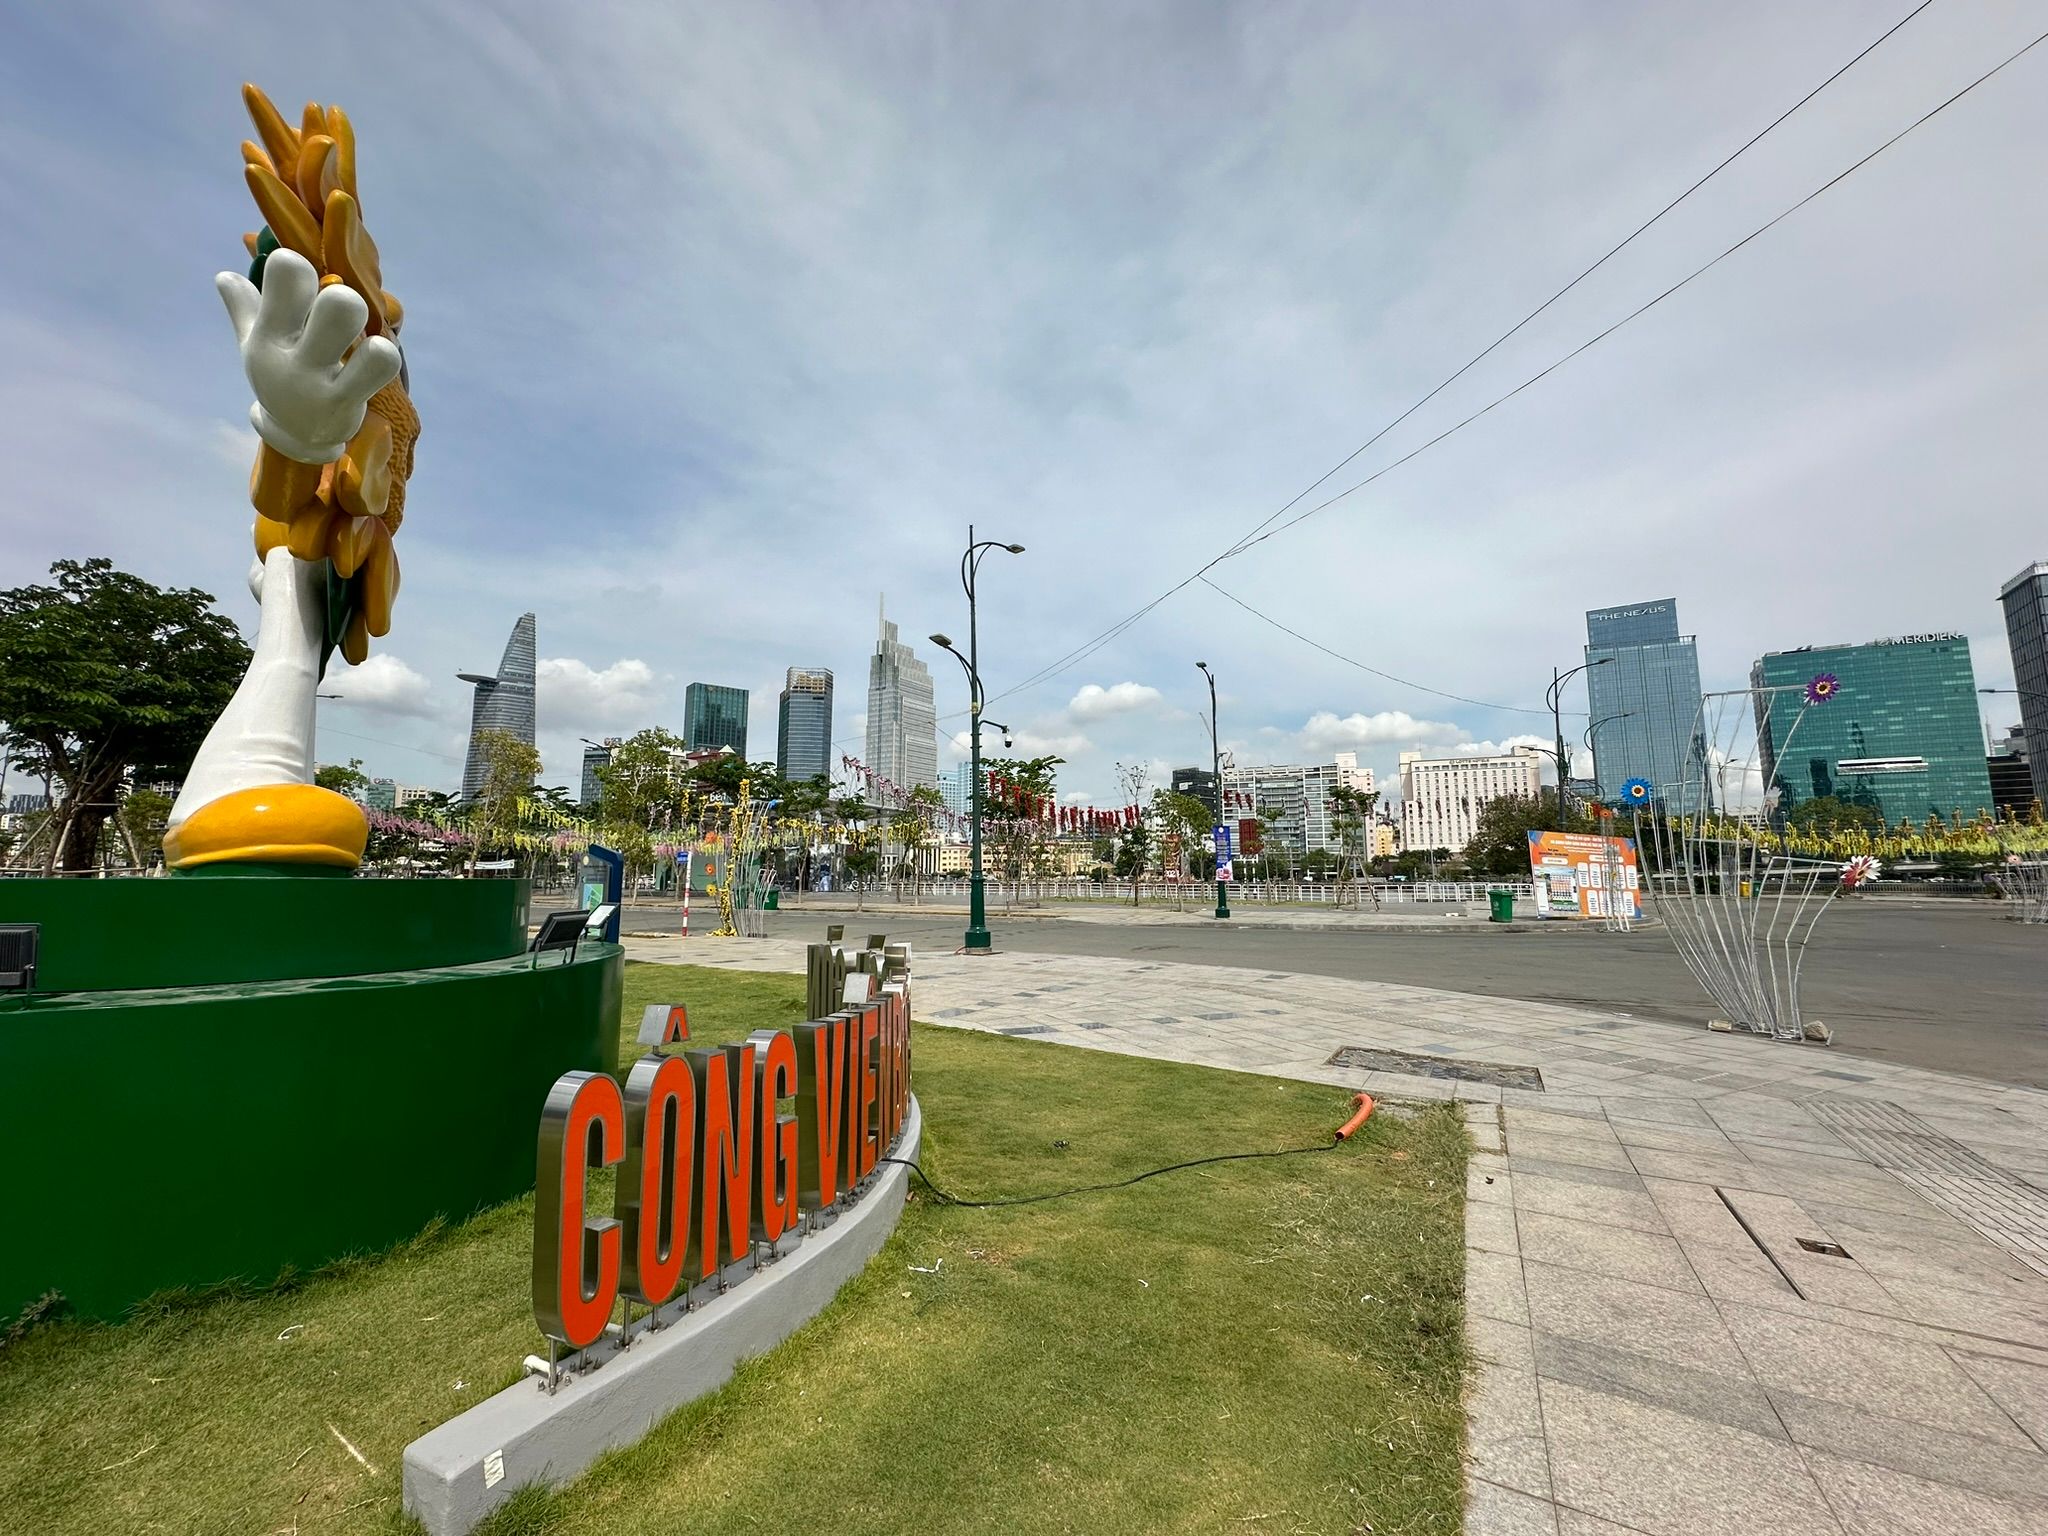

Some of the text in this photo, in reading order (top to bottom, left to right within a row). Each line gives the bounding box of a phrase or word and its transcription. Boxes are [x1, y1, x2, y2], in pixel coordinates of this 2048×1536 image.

[1598, 605, 1666, 621] THE NEXUS
[533, 1003, 798, 1348] CÔNG
